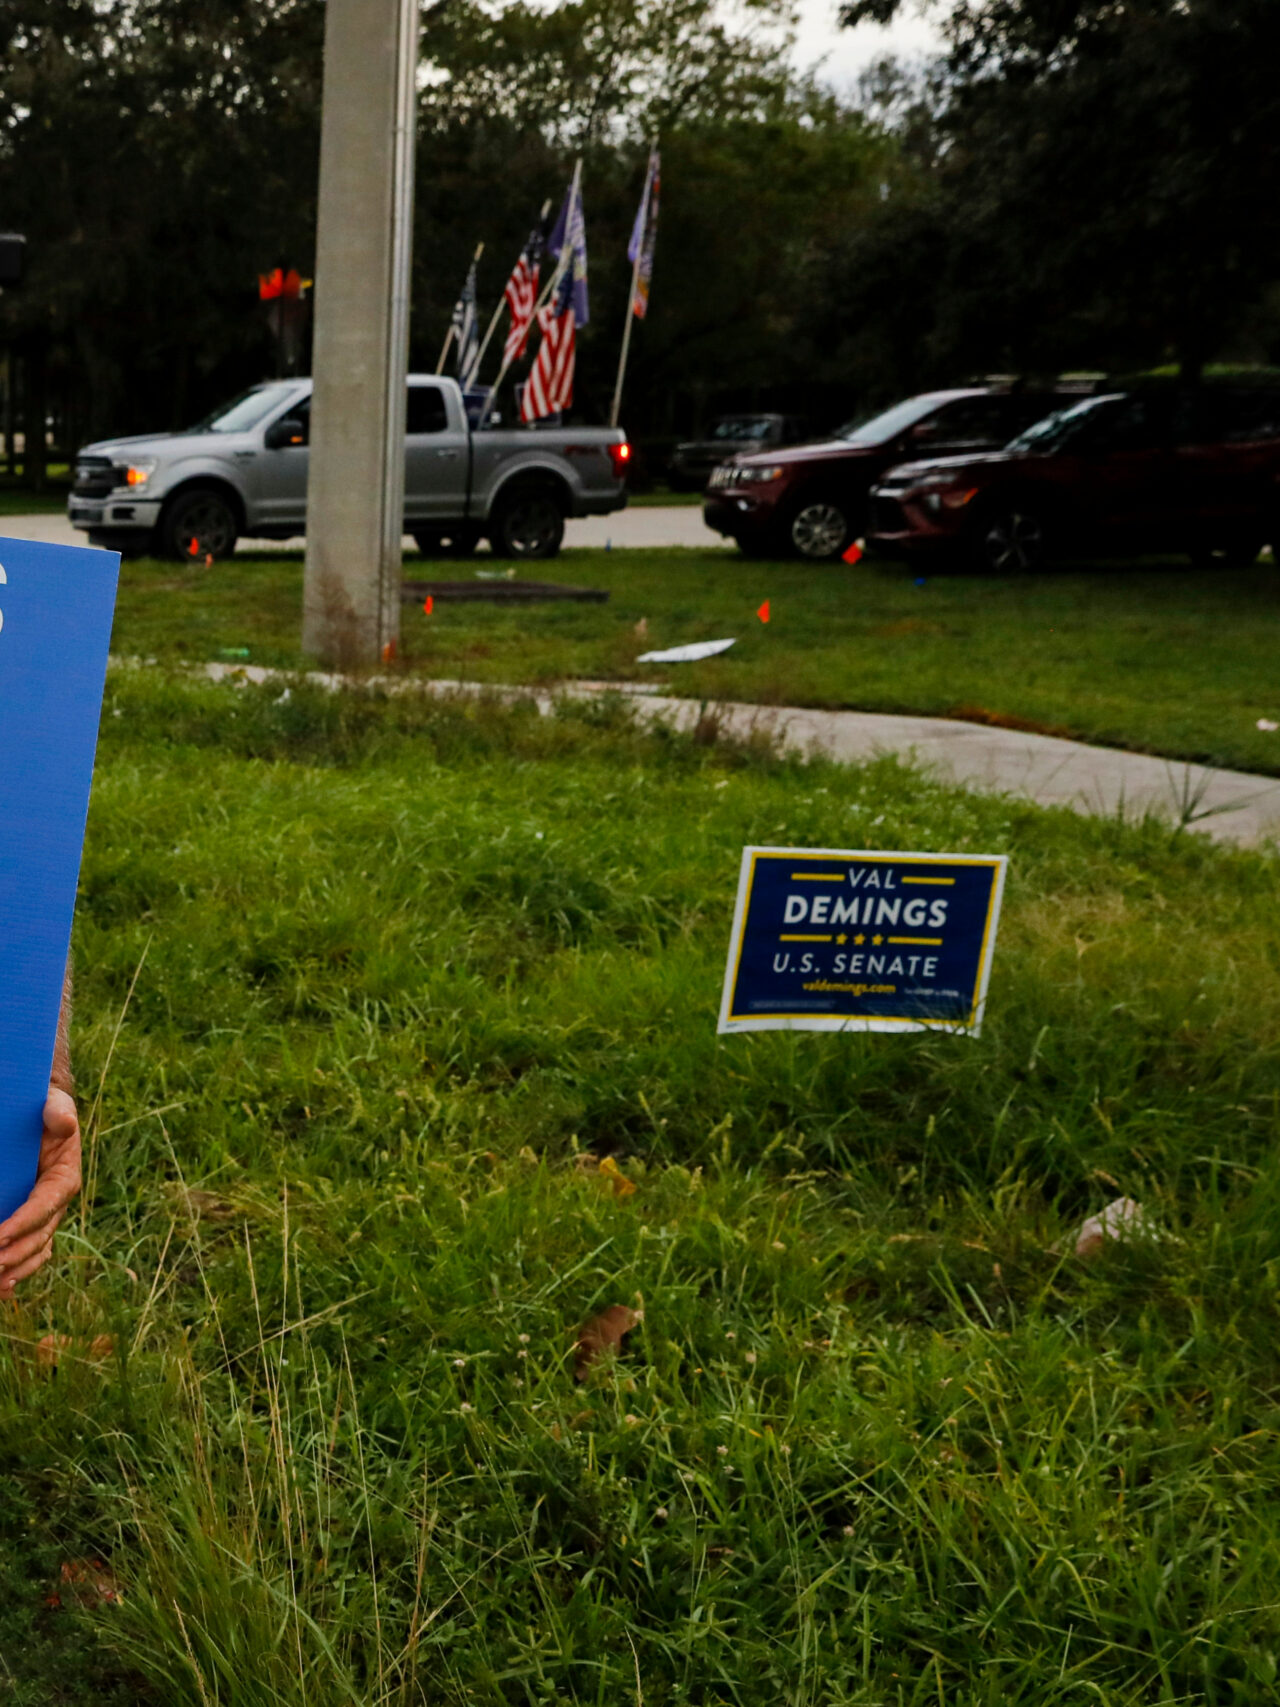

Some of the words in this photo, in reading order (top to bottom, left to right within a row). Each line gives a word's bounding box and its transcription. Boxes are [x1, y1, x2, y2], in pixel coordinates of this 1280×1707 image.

[848, 868, 897, 889] VAL
[783, 895, 949, 928] DEMINGS
[773, 953, 821, 973] U.S.
[833, 953, 939, 977] SENATE
[802, 979, 897, 996] valdemings.com
